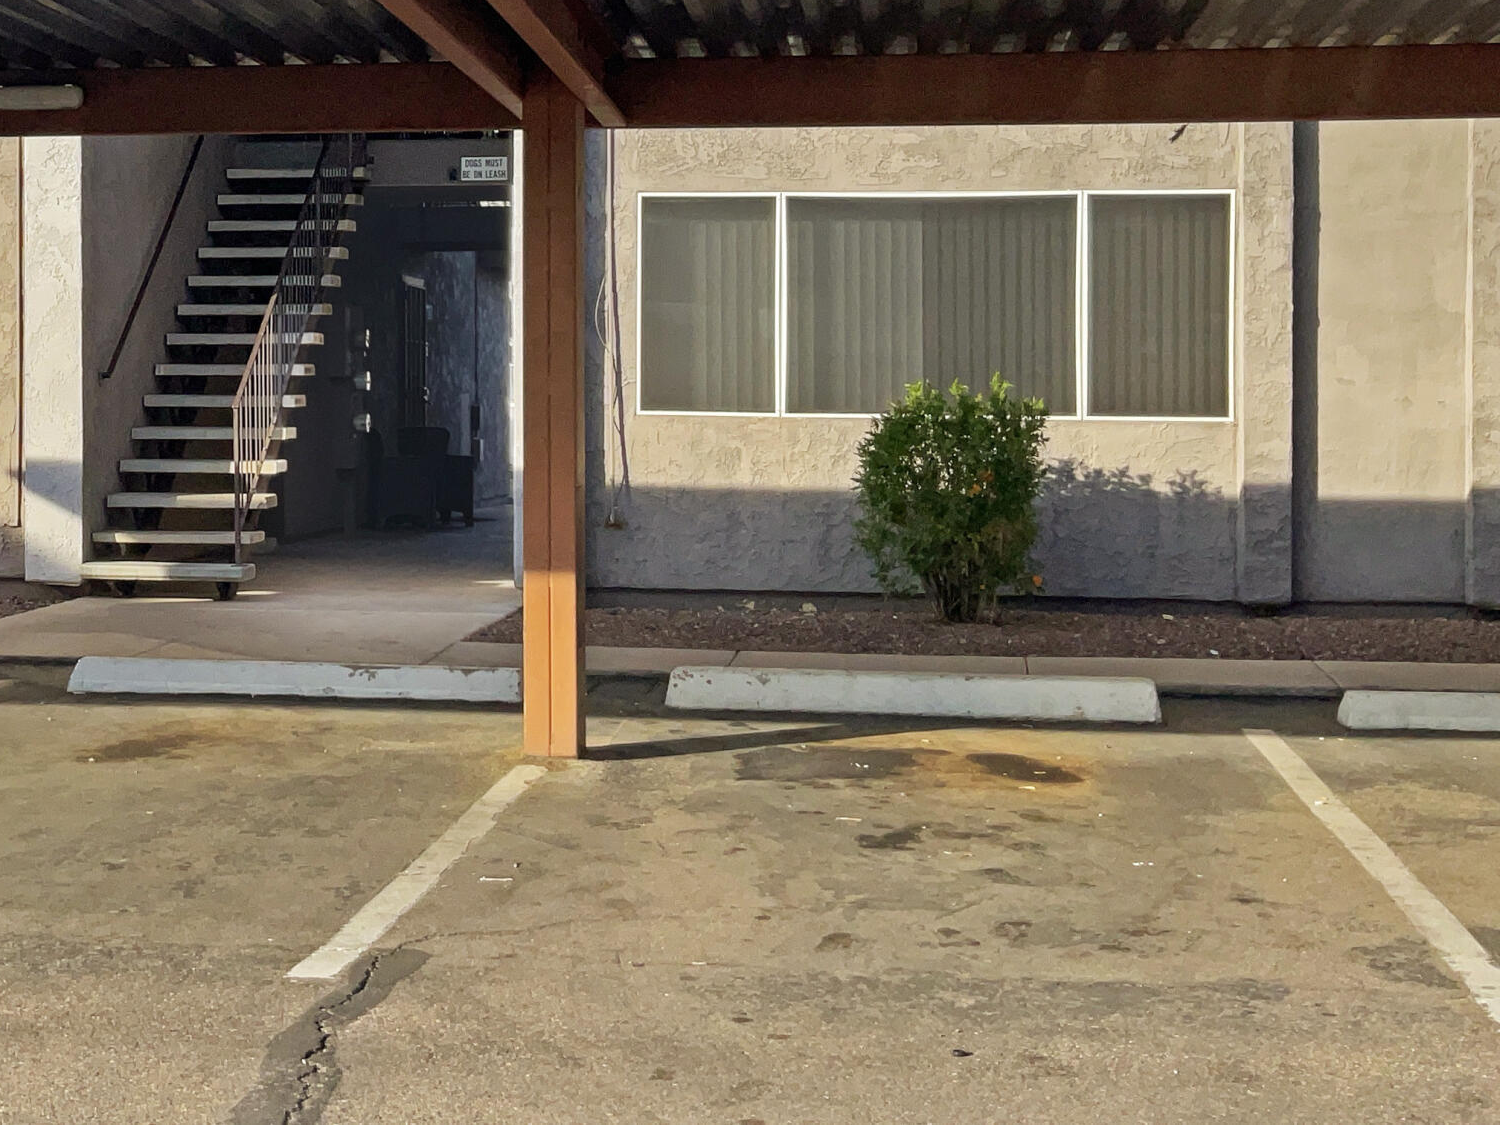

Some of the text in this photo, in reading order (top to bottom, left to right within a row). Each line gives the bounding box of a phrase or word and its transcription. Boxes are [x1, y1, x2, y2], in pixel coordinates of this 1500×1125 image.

[465, 159, 503, 167] DOGS MUST
[485, 170, 506, 178] LEASH
